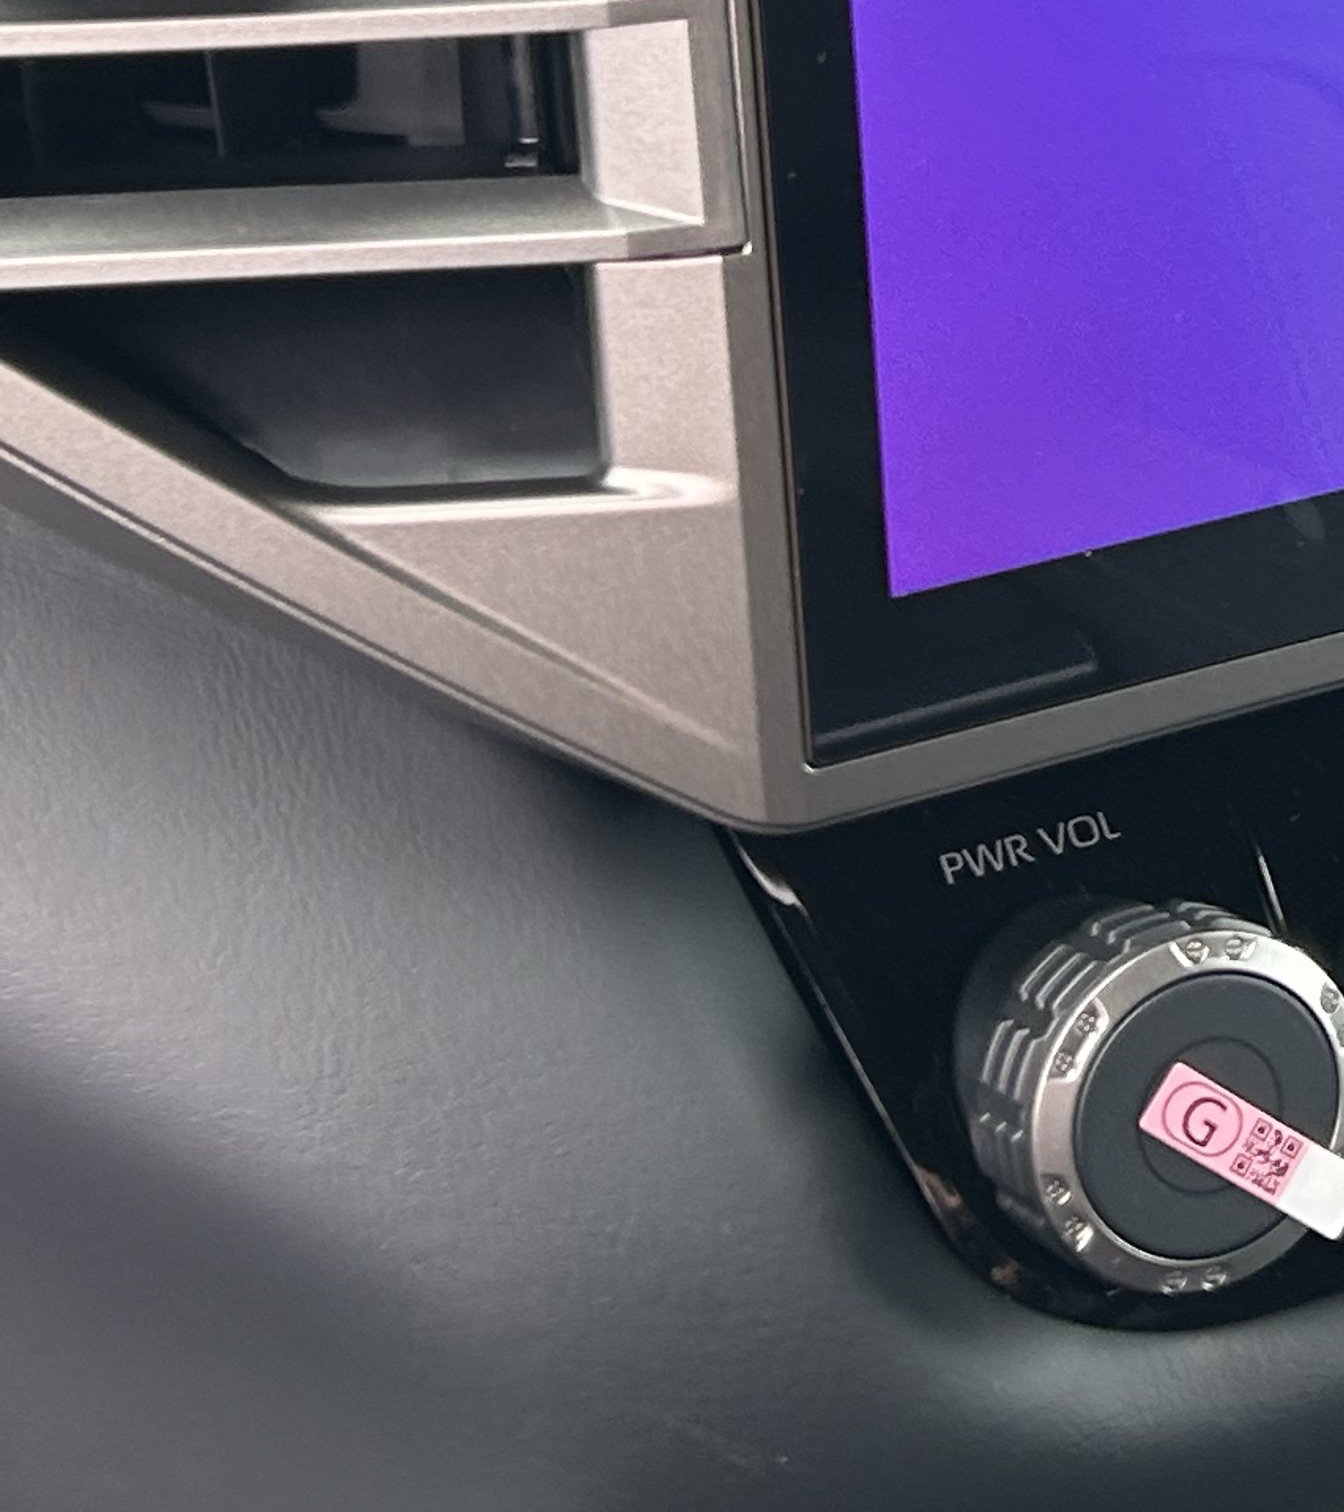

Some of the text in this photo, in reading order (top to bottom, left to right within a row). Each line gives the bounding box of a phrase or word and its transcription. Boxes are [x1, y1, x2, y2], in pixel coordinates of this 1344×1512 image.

[940, 811, 1122, 885] PWR VOL
[1182, 1097, 1228, 1147] G
